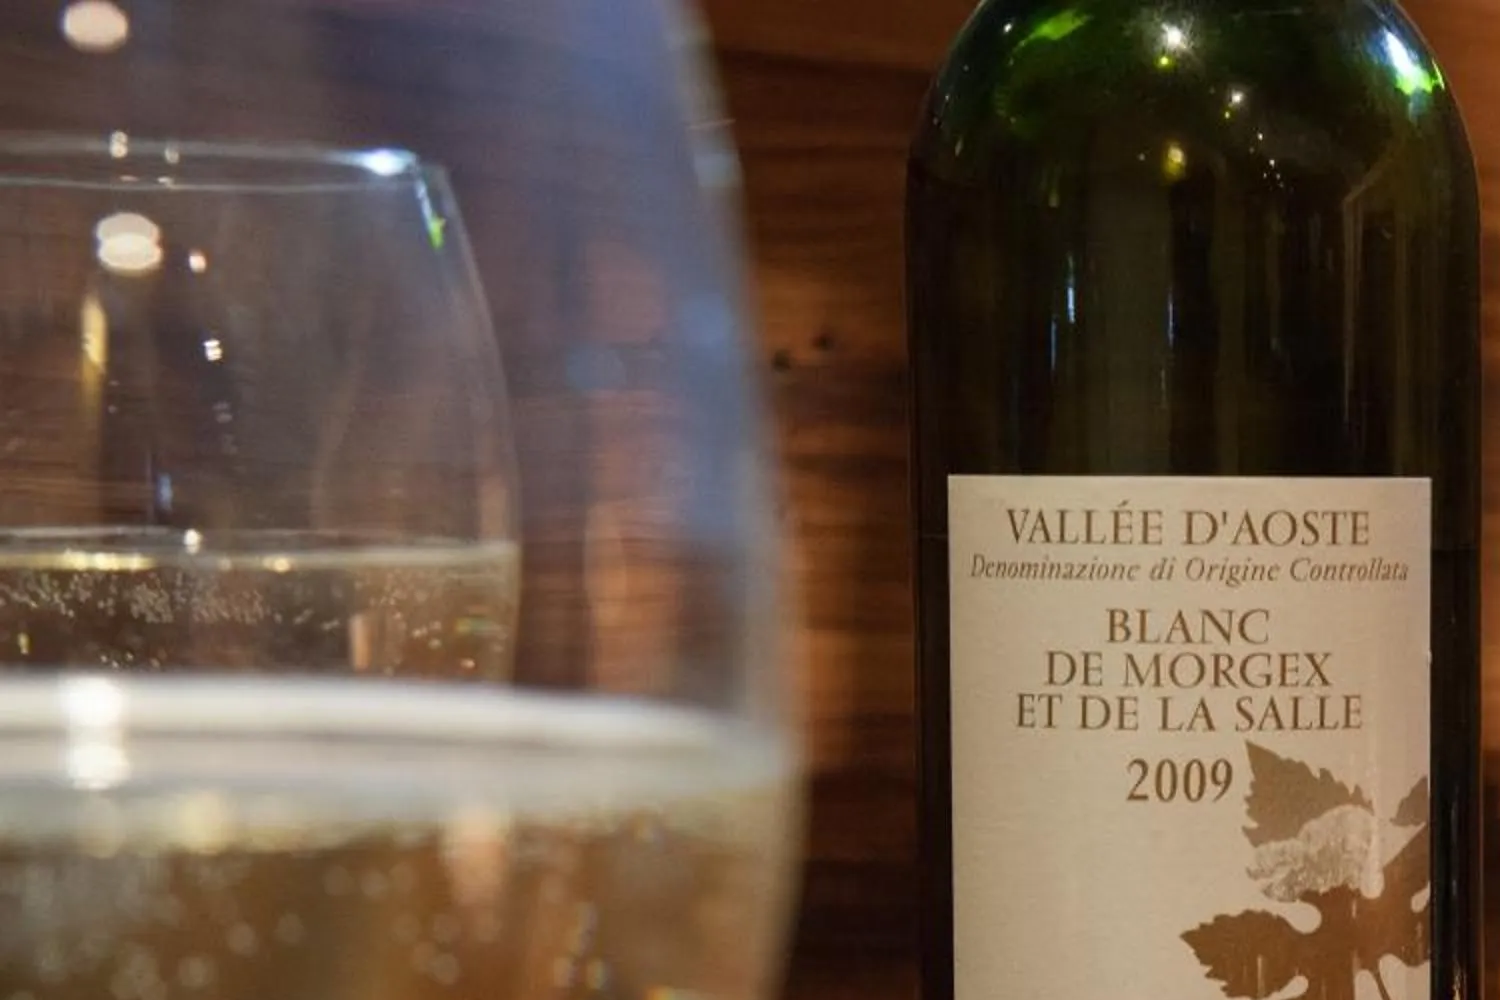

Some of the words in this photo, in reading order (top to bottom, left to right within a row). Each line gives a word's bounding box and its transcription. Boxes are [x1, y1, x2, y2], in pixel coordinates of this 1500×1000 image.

[1006, 500, 1163, 545] VALLÉE
[1182, 509, 1370, 547] D'AOSTE
[970, 552, 1140, 582] Denominazione
[1149, 556, 1176, 582] di
[1185, 556, 1281, 588] Origine
[1289, 556, 1409, 583] Controllata
[1106, 607, 1270, 645] BLANC
[1045, 651, 1103, 687] DE
[1122, 651, 1332, 689] MORGEX
[1016, 693, 1063, 729] ET
[1078, 695, 1139, 731] DE
[1158, 696, 1216, 732] LA
[1235, 694, 1363, 732] SALLE
[1126, 758, 1234, 803] 2009
